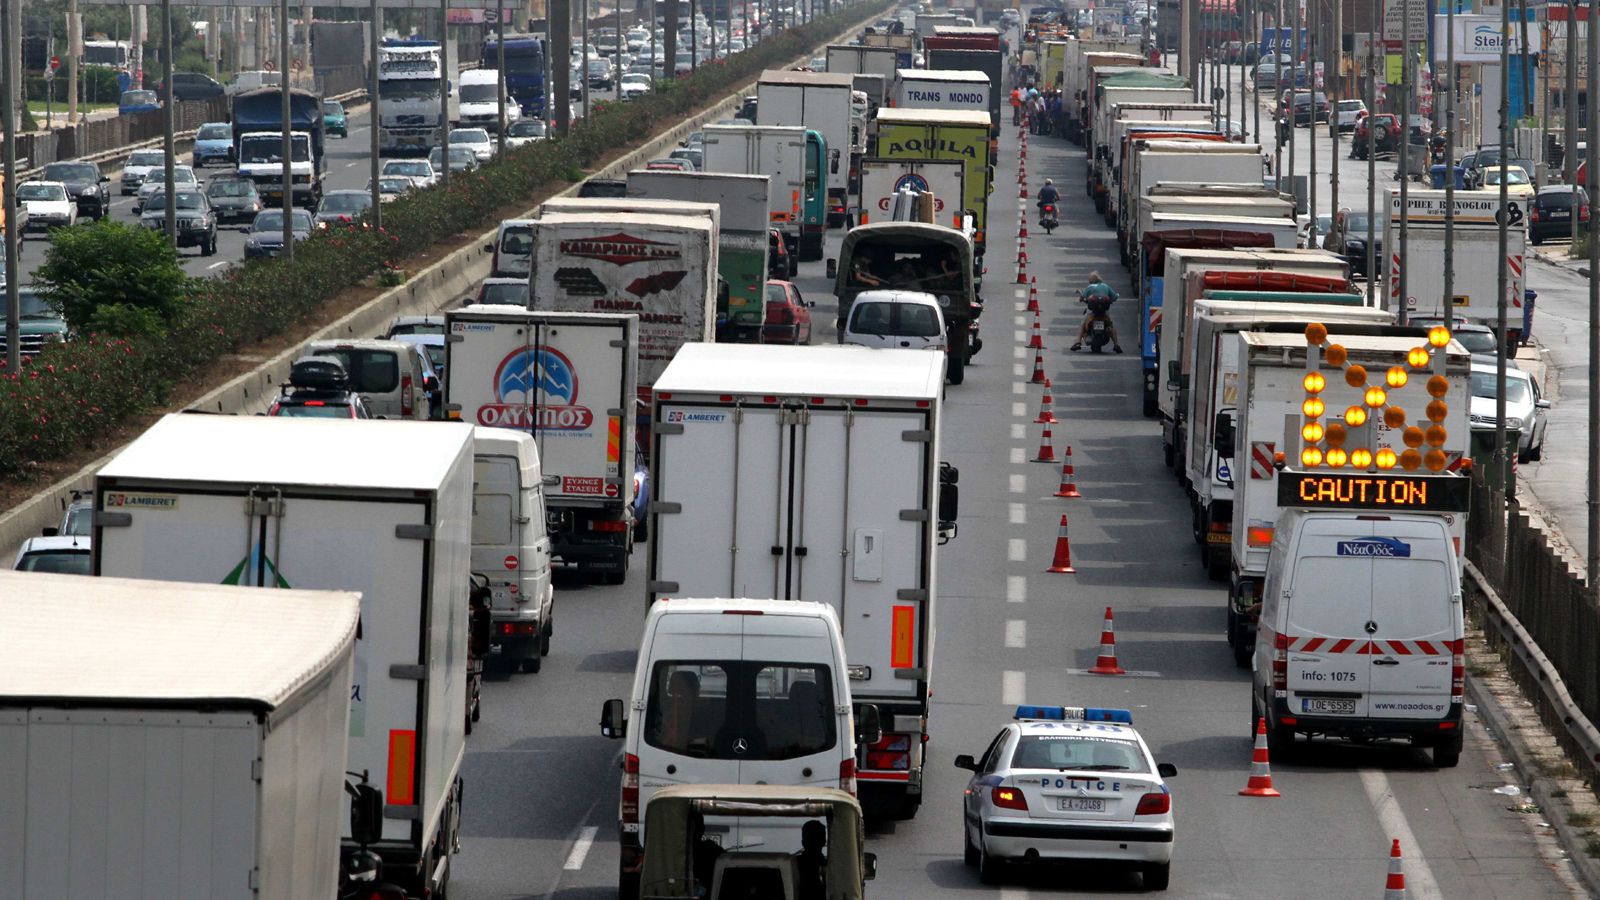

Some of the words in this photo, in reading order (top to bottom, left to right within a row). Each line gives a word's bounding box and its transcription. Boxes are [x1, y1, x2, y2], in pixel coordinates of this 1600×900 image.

[908, 91, 941, 102] TRANS
[949, 92, 983, 104] MONDO
[889, 139, 976, 158] AQUILA
[1393, 200, 1433, 209] OPHEE
[683, 414, 726, 422] LAMBERET
[566, 485, 599, 493] ΣΤΑΣΕΙΣ
[1300, 478, 1427, 504] CAUTION
[124, 496, 177, 506] LAMBERET
[1302, 670, 1327, 681] info:
[1331, 671, 1356, 682] 1075
[1375, 702, 1445, 712] www.neaodos.gr
[1064, 708, 1084, 720] POLICE
[1041, 778, 1120, 792] POLICE
